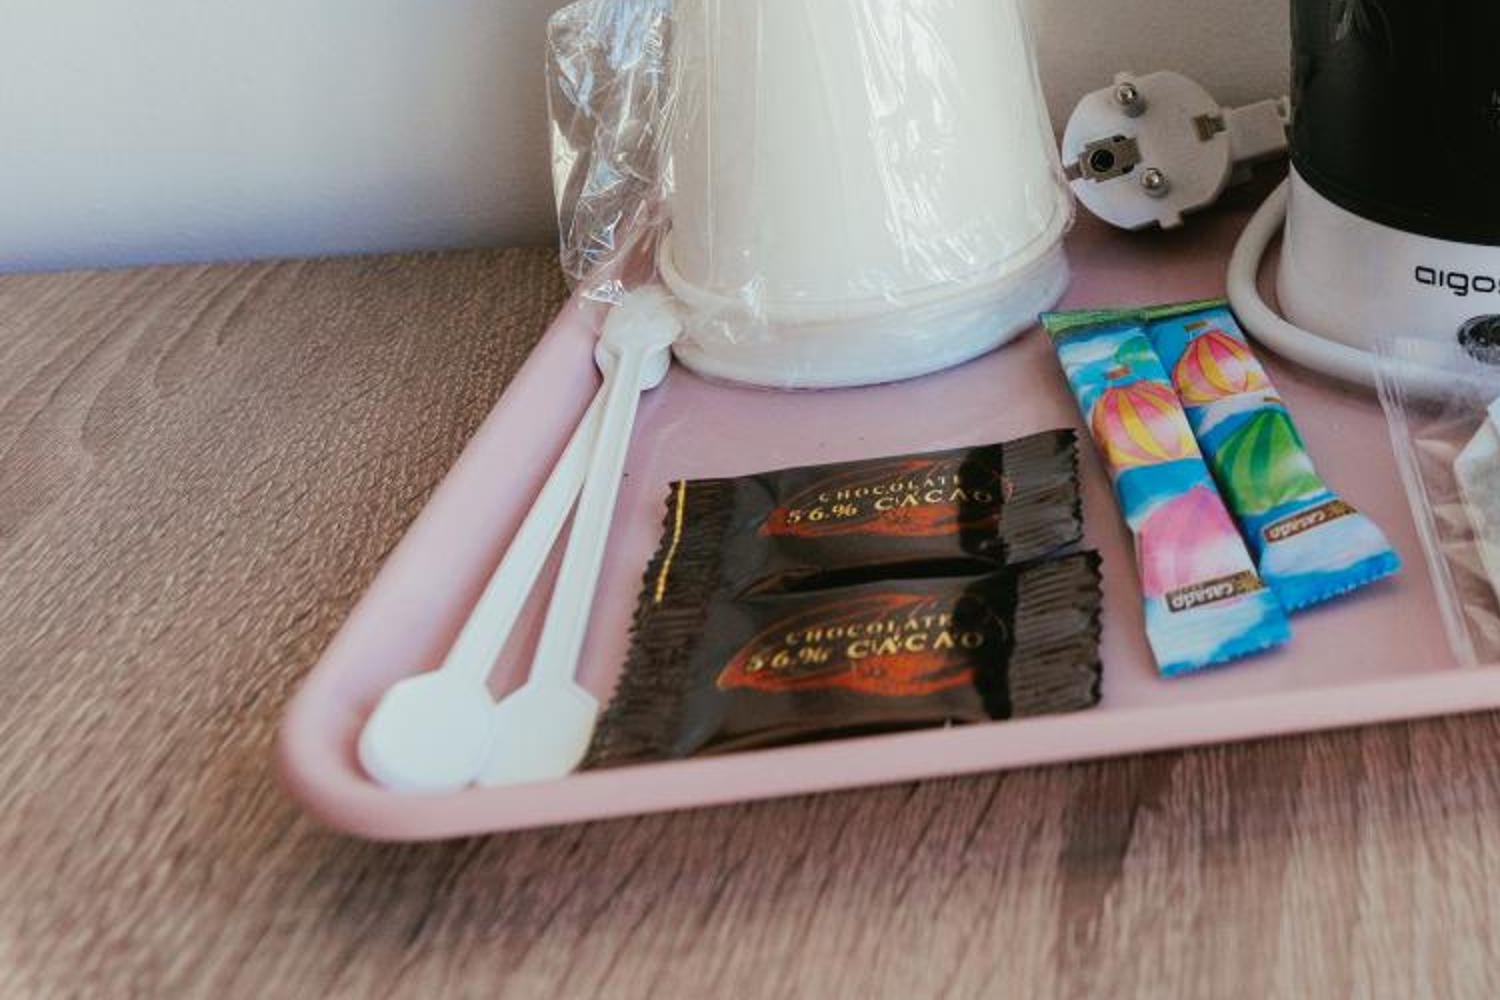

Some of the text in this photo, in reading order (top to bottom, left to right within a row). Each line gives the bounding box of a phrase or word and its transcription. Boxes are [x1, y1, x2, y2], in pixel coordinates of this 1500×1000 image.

[873, 486, 993, 512] CACAO
[784, 612, 953, 646] CHOCOLATE
[846, 630, 985, 660] CACAO
